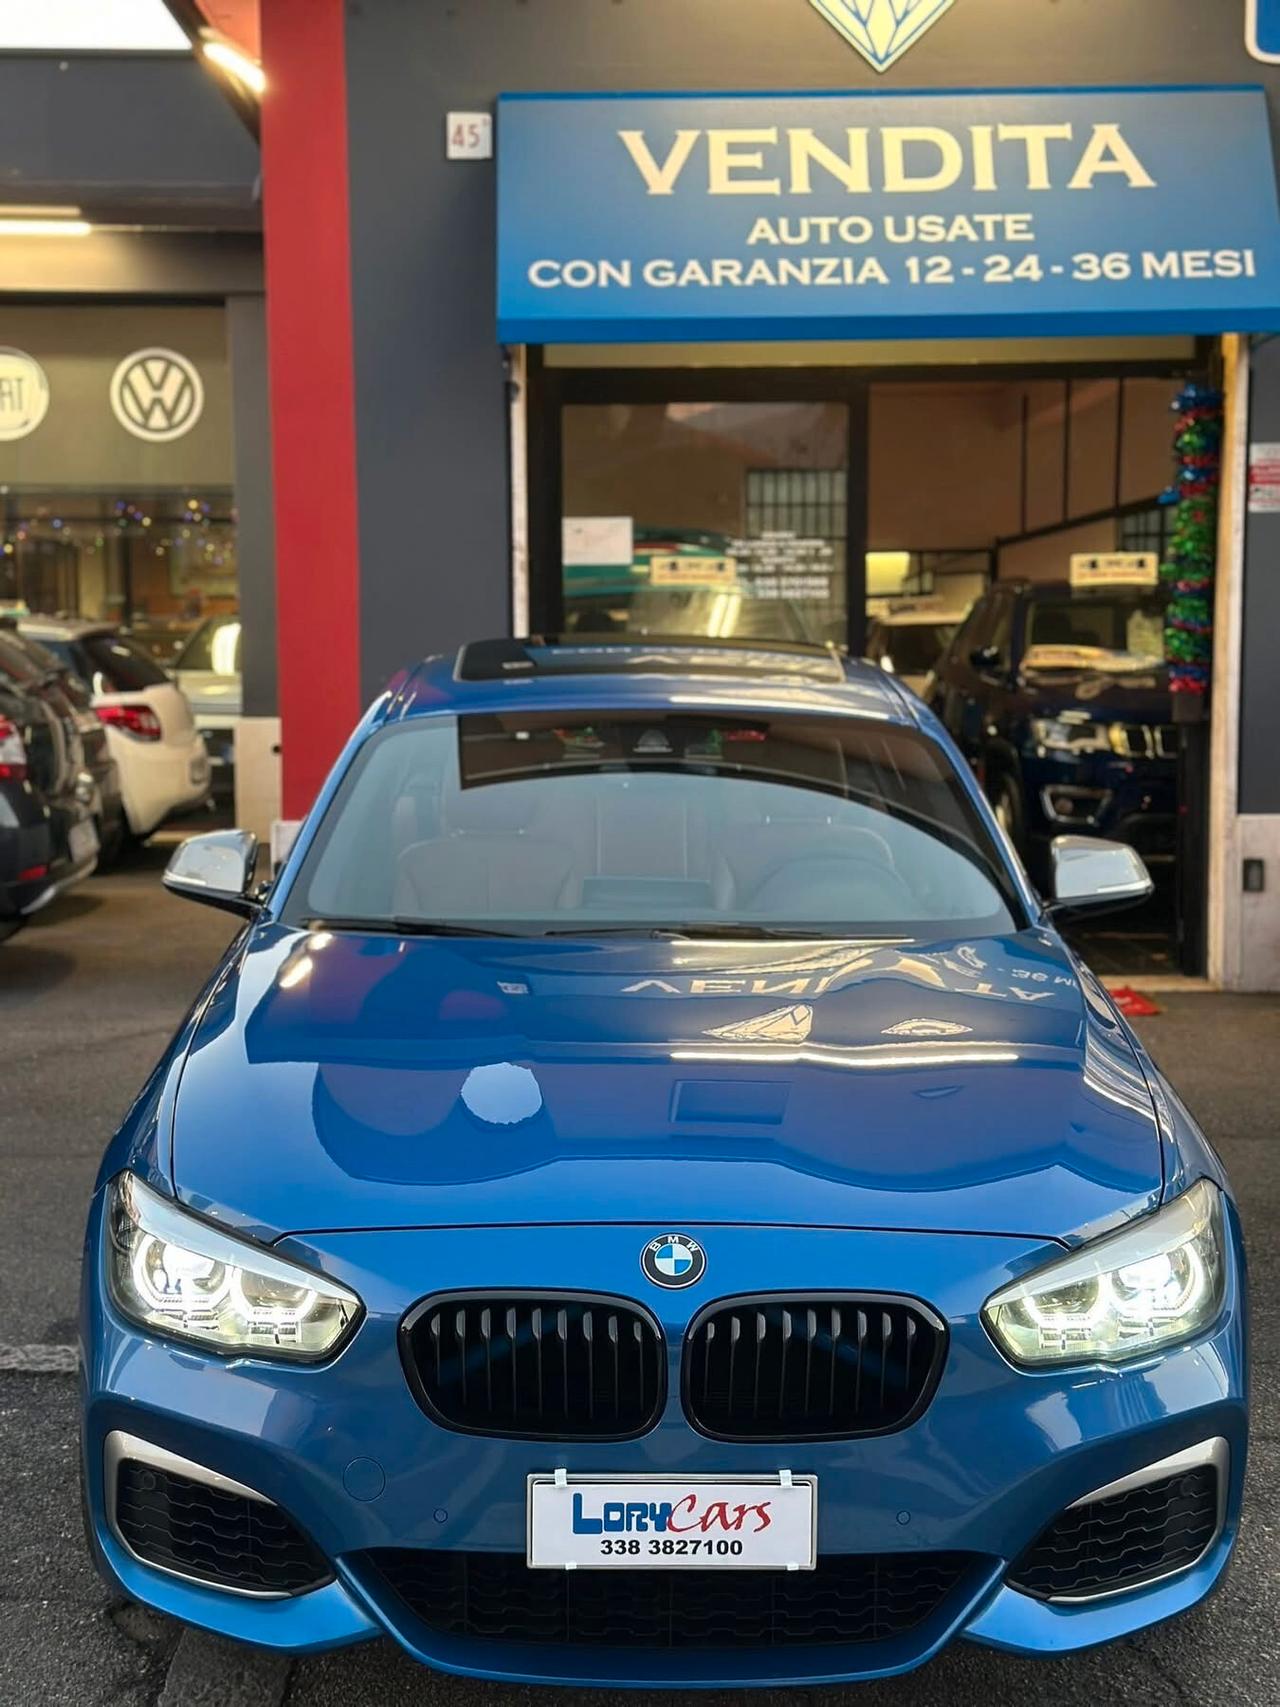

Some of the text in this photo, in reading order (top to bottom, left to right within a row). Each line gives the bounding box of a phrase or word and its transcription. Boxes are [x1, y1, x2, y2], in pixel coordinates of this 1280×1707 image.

[451, 123, 481, 149] 45
[617, 122, 1156, 197] VENDITA
[746, 212, 1034, 246] AUTO USATE
[529, 260, 631, 288] CON
[643, 256, 890, 288] GARANZIA
[906, 255, 955, 284] 12
[983, 254, 1043, 283] 24
[1072, 252, 1131, 281] 36
[1142, 249, 1255, 280] MESI
[648, 1235, 701, 1252] BMW
[600, 1539, 743, 1556] 338 3827100
